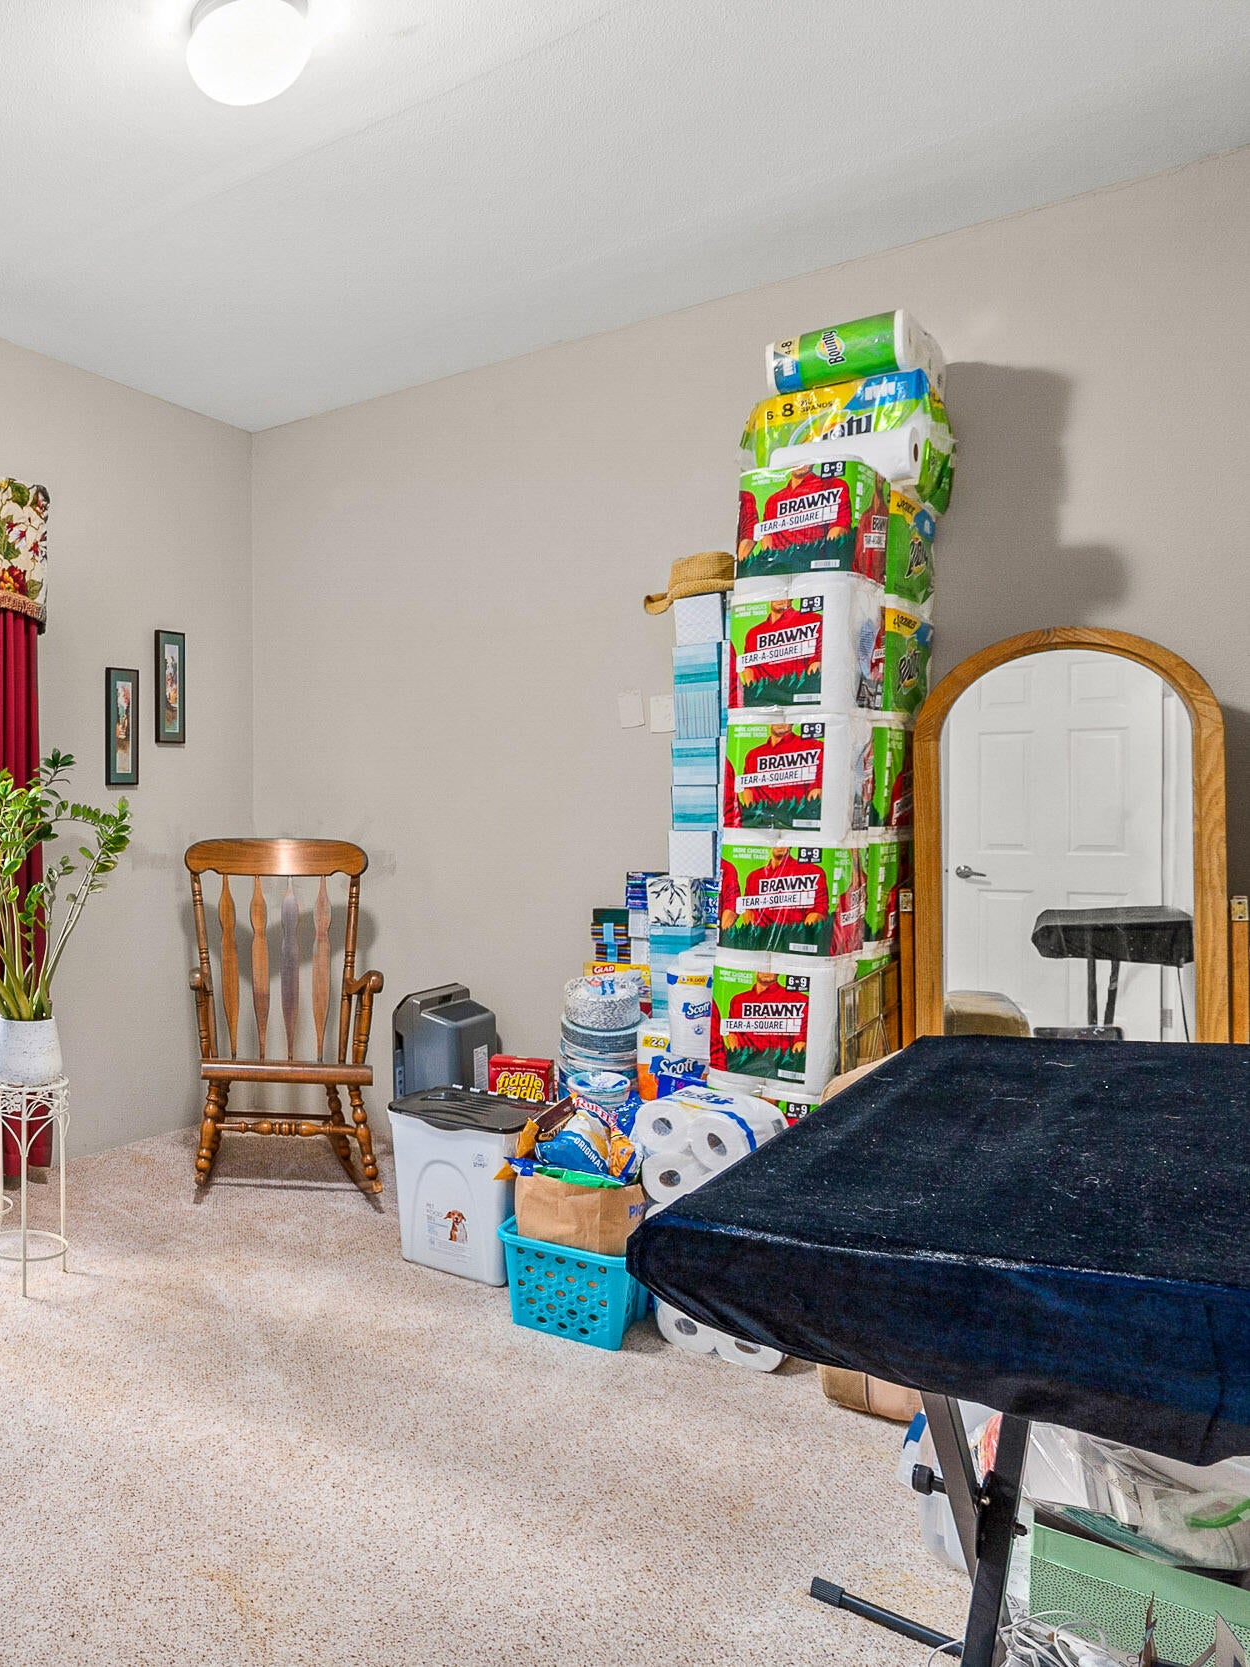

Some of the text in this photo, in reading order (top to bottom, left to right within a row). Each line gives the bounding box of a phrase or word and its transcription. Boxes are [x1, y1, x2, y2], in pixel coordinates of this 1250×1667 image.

[822, 330, 846, 365] Bounty
[779, 490, 841, 516] BRAWNY
[760, 510, 820, 533] TEAR-A-SQUARE
[759, 624, 817, 648] BRAWNY
[741, 645, 798, 664] TEAR-A-SQUARE
[759, 751, 818, 770] BRAWNY
[740, 770, 799, 785] TEAR-A-SQUARE
[761, 876, 817, 893] BRAWNY
[742, 894, 797, 907] TEAR-A-SQUARE
[594, 966, 615, 974] GLAD
[686, 1002, 710, 1015] Scott
[744, 1004, 803, 1016] BRAWNY
[726, 1020, 783, 1029] TEAR-A-SQUARE
[651, 1038, 664, 1047] 24
[658, 1057, 696, 1075] Scott
[499, 1073, 543, 1090] fiddle
[574, 1137, 605, 1171] ORIGINAL
